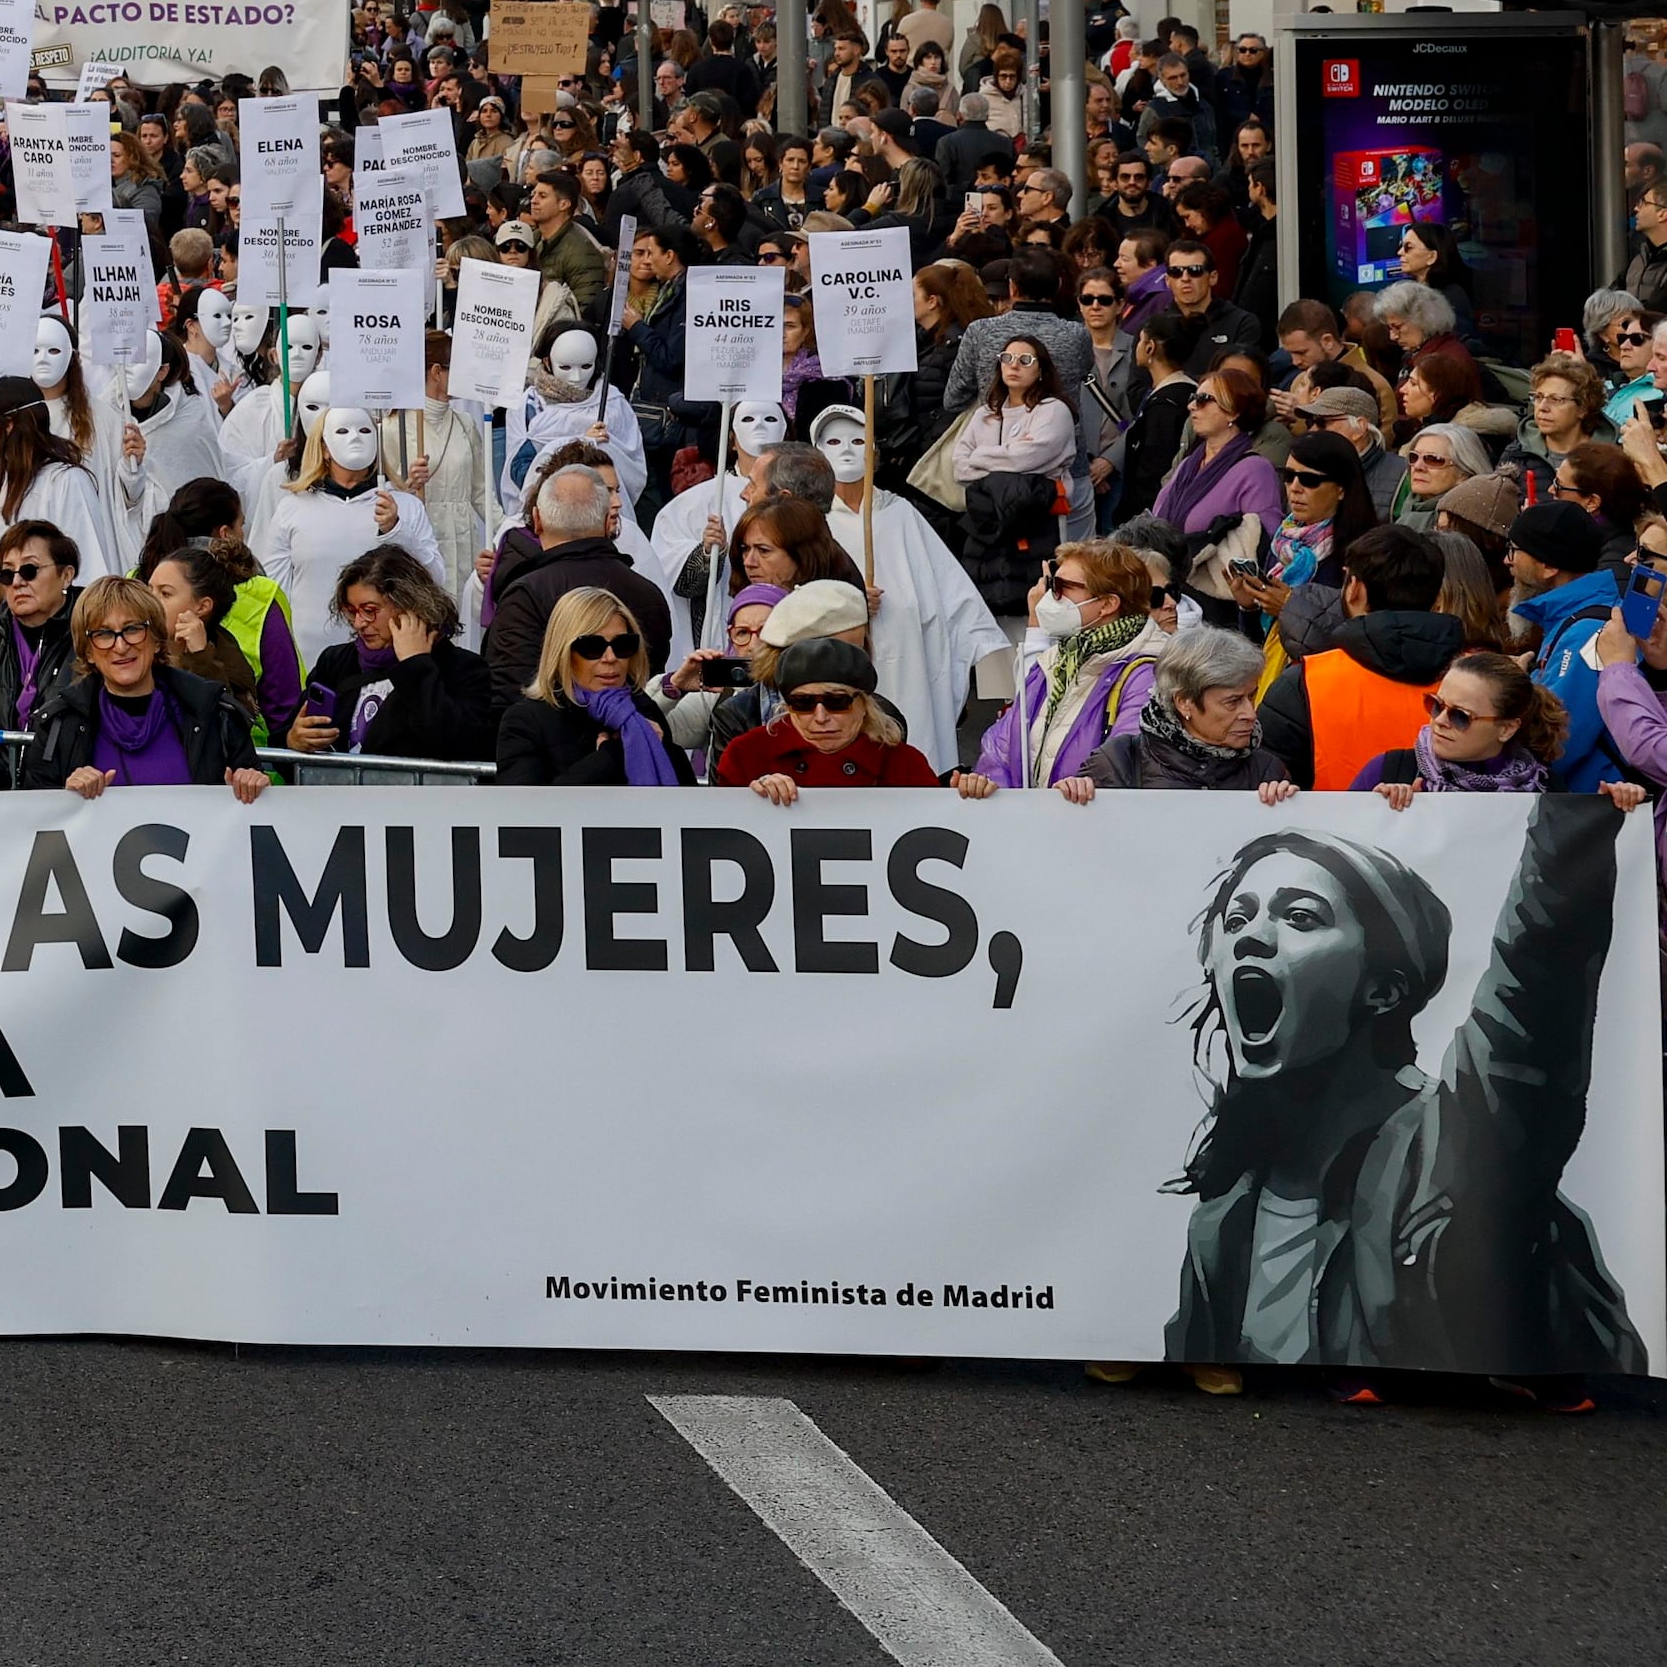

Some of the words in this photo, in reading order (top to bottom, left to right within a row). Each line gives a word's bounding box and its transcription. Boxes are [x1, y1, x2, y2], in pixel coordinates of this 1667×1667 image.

[54, 2, 142, 25] PACTO
[149, 3, 178, 22] DE
[185, 3, 295, 25] ESTADO?
[1373, 84, 1445, 96] NINTENDO
[1389, 99, 1448, 111] MODELO
[1377, 116, 1407, 124] MARIO
[13, 136, 64, 151] ARANTXA
[257, 138, 304, 154] ELENA
[23, 151, 54, 164] CARO
[93, 265, 138, 282] ILHAM
[821, 269, 903, 286] CAROLINA
[93, 286, 141, 303] NAJAH
[848, 286, 880, 300] V.C.
[719, 299, 751, 312] IRIS
[353, 314, 402, 329] ROSA
[693, 311, 775, 328] SÁNCHEZ
[1559, 649, 1572, 677] Joma
[250, 824, 1023, 1009] MUJERES,
[545, 1275, 728, 1302] Movimiento
[736, 1279, 887, 1306] Feminista
[896, 1282, 934, 1307] de
[943, 1284, 1055, 1310] Madrid
